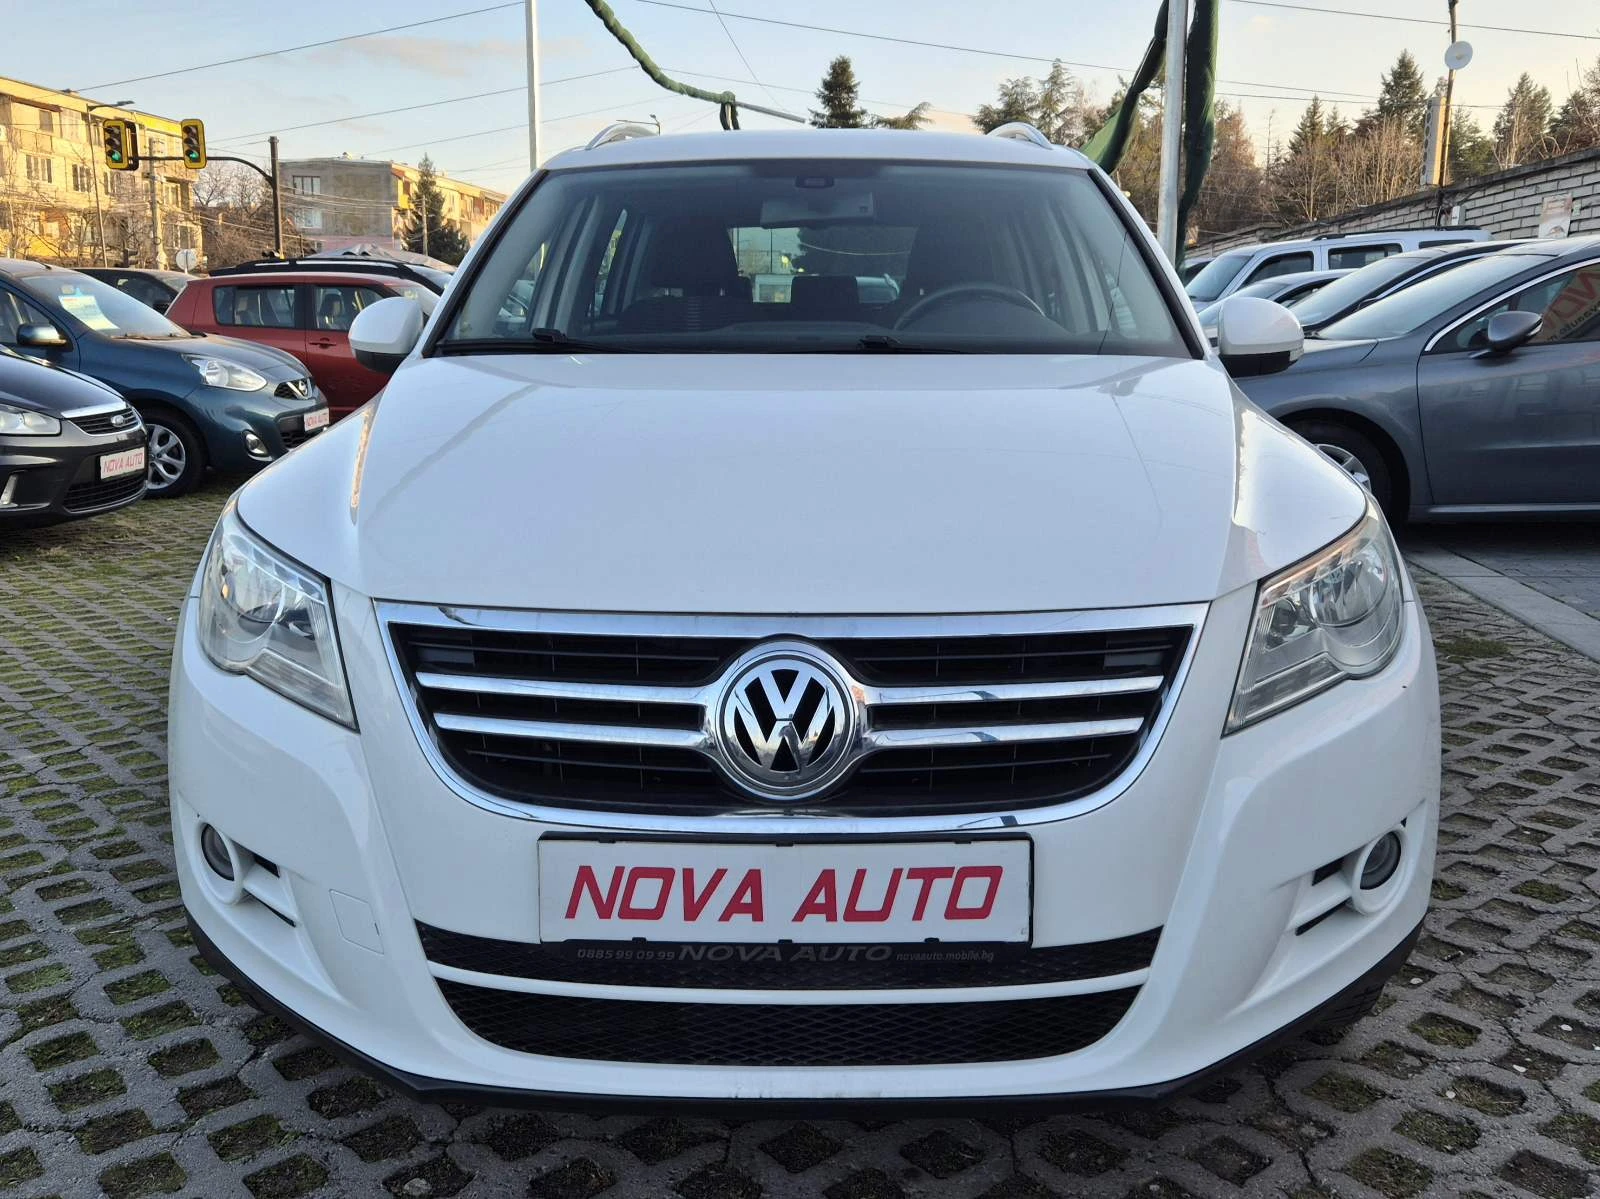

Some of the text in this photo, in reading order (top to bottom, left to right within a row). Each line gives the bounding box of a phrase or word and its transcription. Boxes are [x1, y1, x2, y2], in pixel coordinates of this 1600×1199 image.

[104, 452, 143, 472] NOVA AUTO
[565, 865, 1003, 922] NOVA AUTO
[577, 944, 994, 963] 0885 99 09 99 NOVA AUTO novaauto.mobile.bg
